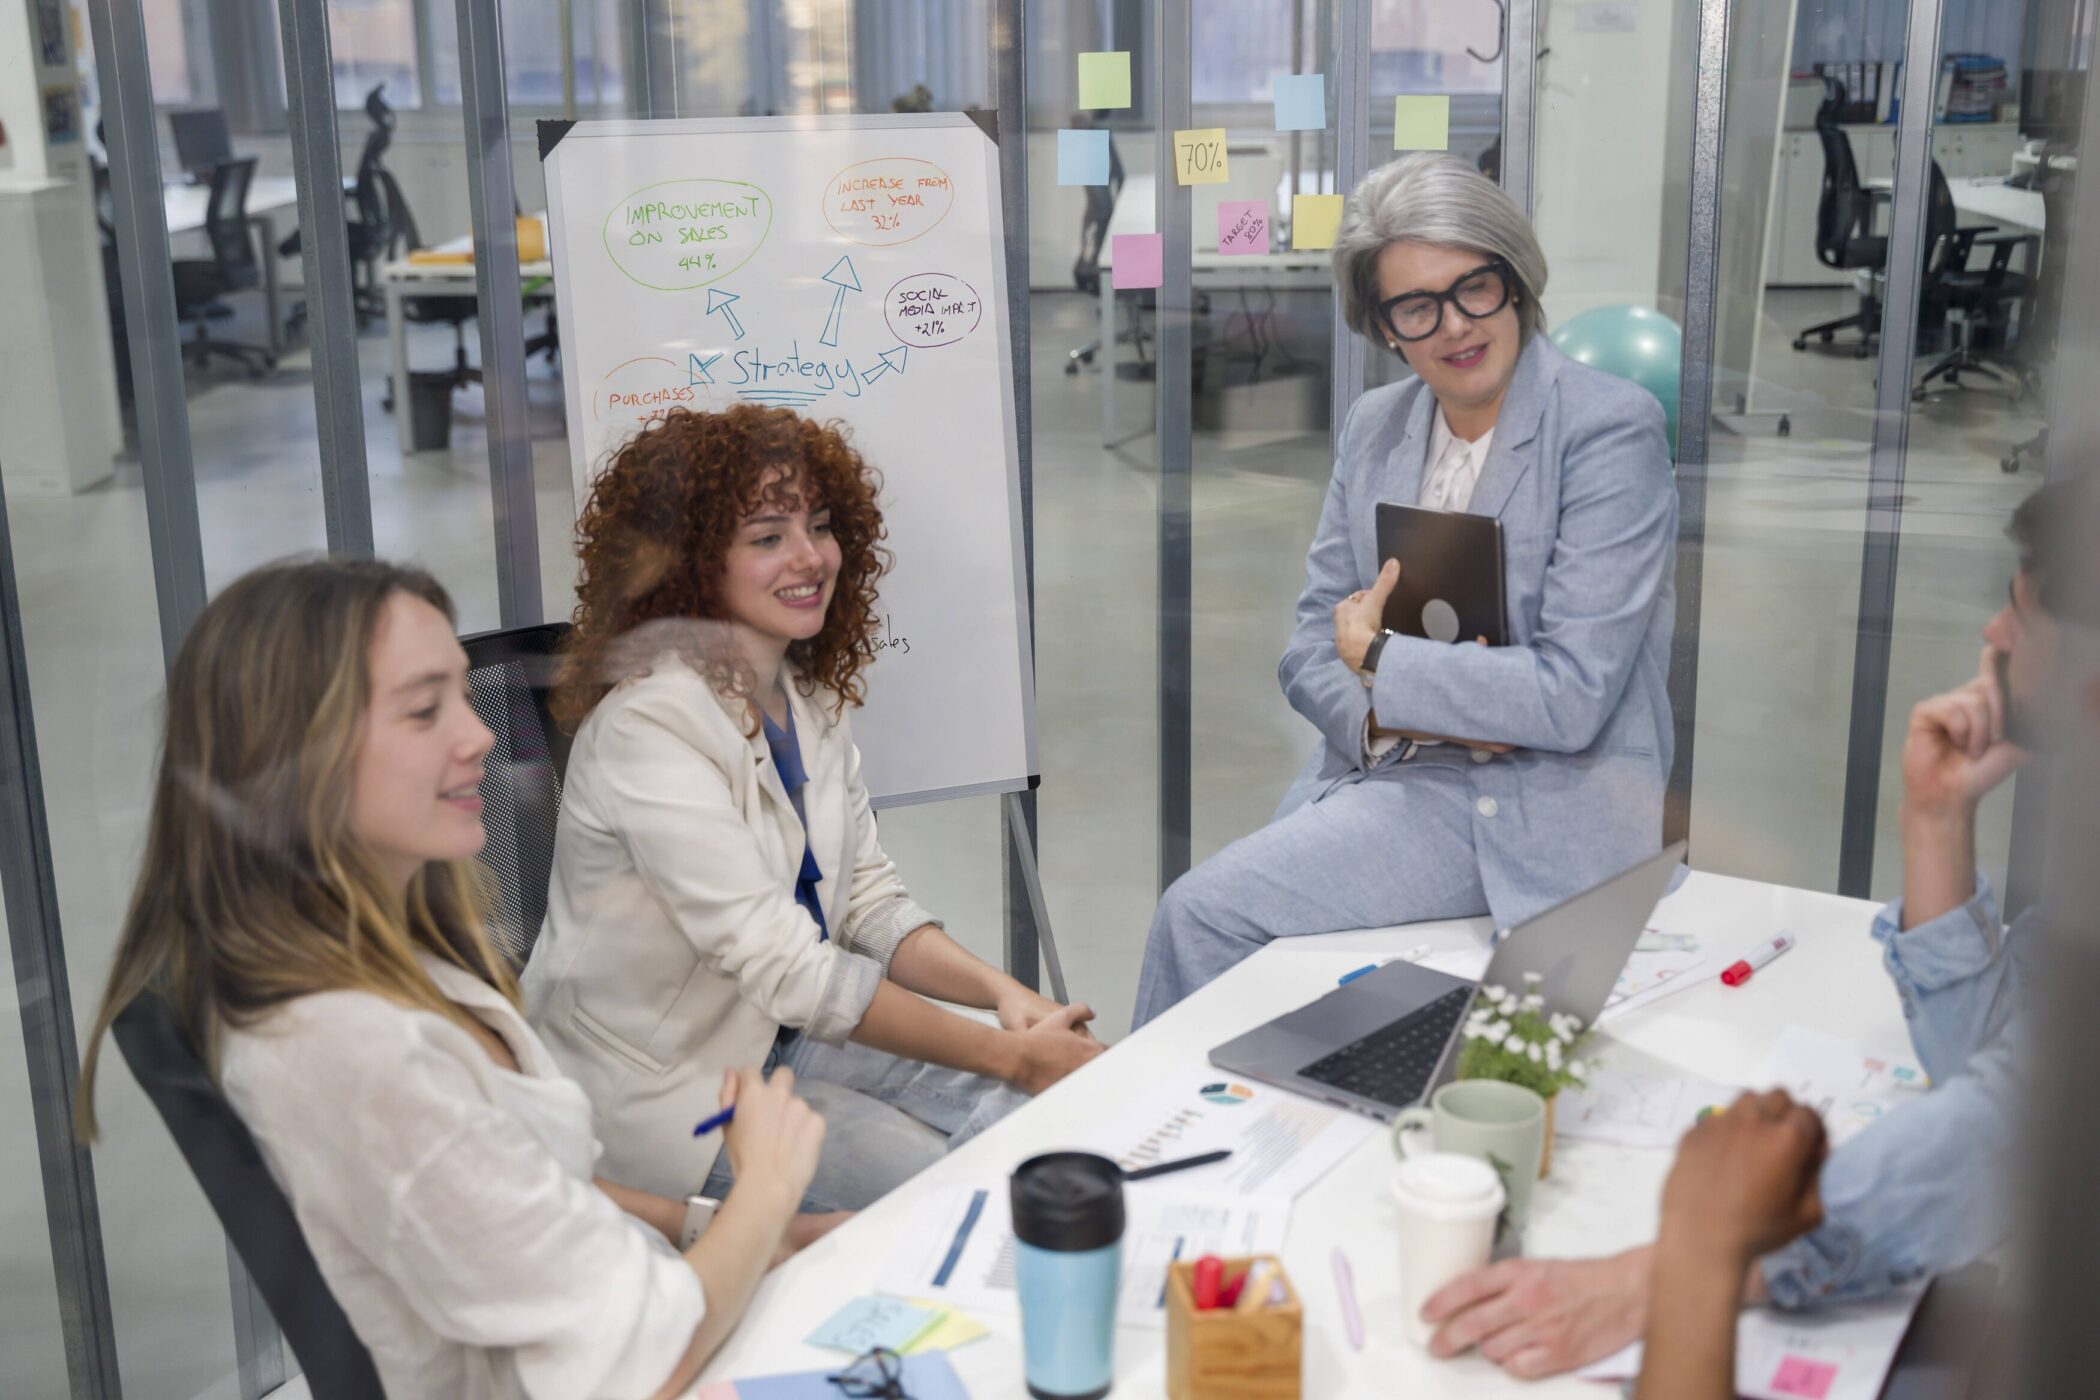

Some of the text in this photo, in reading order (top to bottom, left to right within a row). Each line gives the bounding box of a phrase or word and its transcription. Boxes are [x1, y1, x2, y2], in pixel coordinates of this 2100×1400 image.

[1180, 142, 1222, 175] 70%
[837, 176, 948, 195] INCREASE FROM
[626, 196, 759, 225] IMPROVEMENT
[840, 193, 924, 212] LAST YEAR
[871, 213, 900, 230] 32%
[1222, 209, 1252, 246] TARGET
[1243, 218, 1263, 241] 80%
[628, 225, 728, 246] ON SALES
[678, 253, 717, 271] 44%
[898, 287, 949, 304] SOCIAL
[898, 302, 935, 317] MEDIA
[914, 320, 945, 337] +21%
[728, 340, 861, 397] Strategy
[609, 386, 696, 409] PURCHASES
